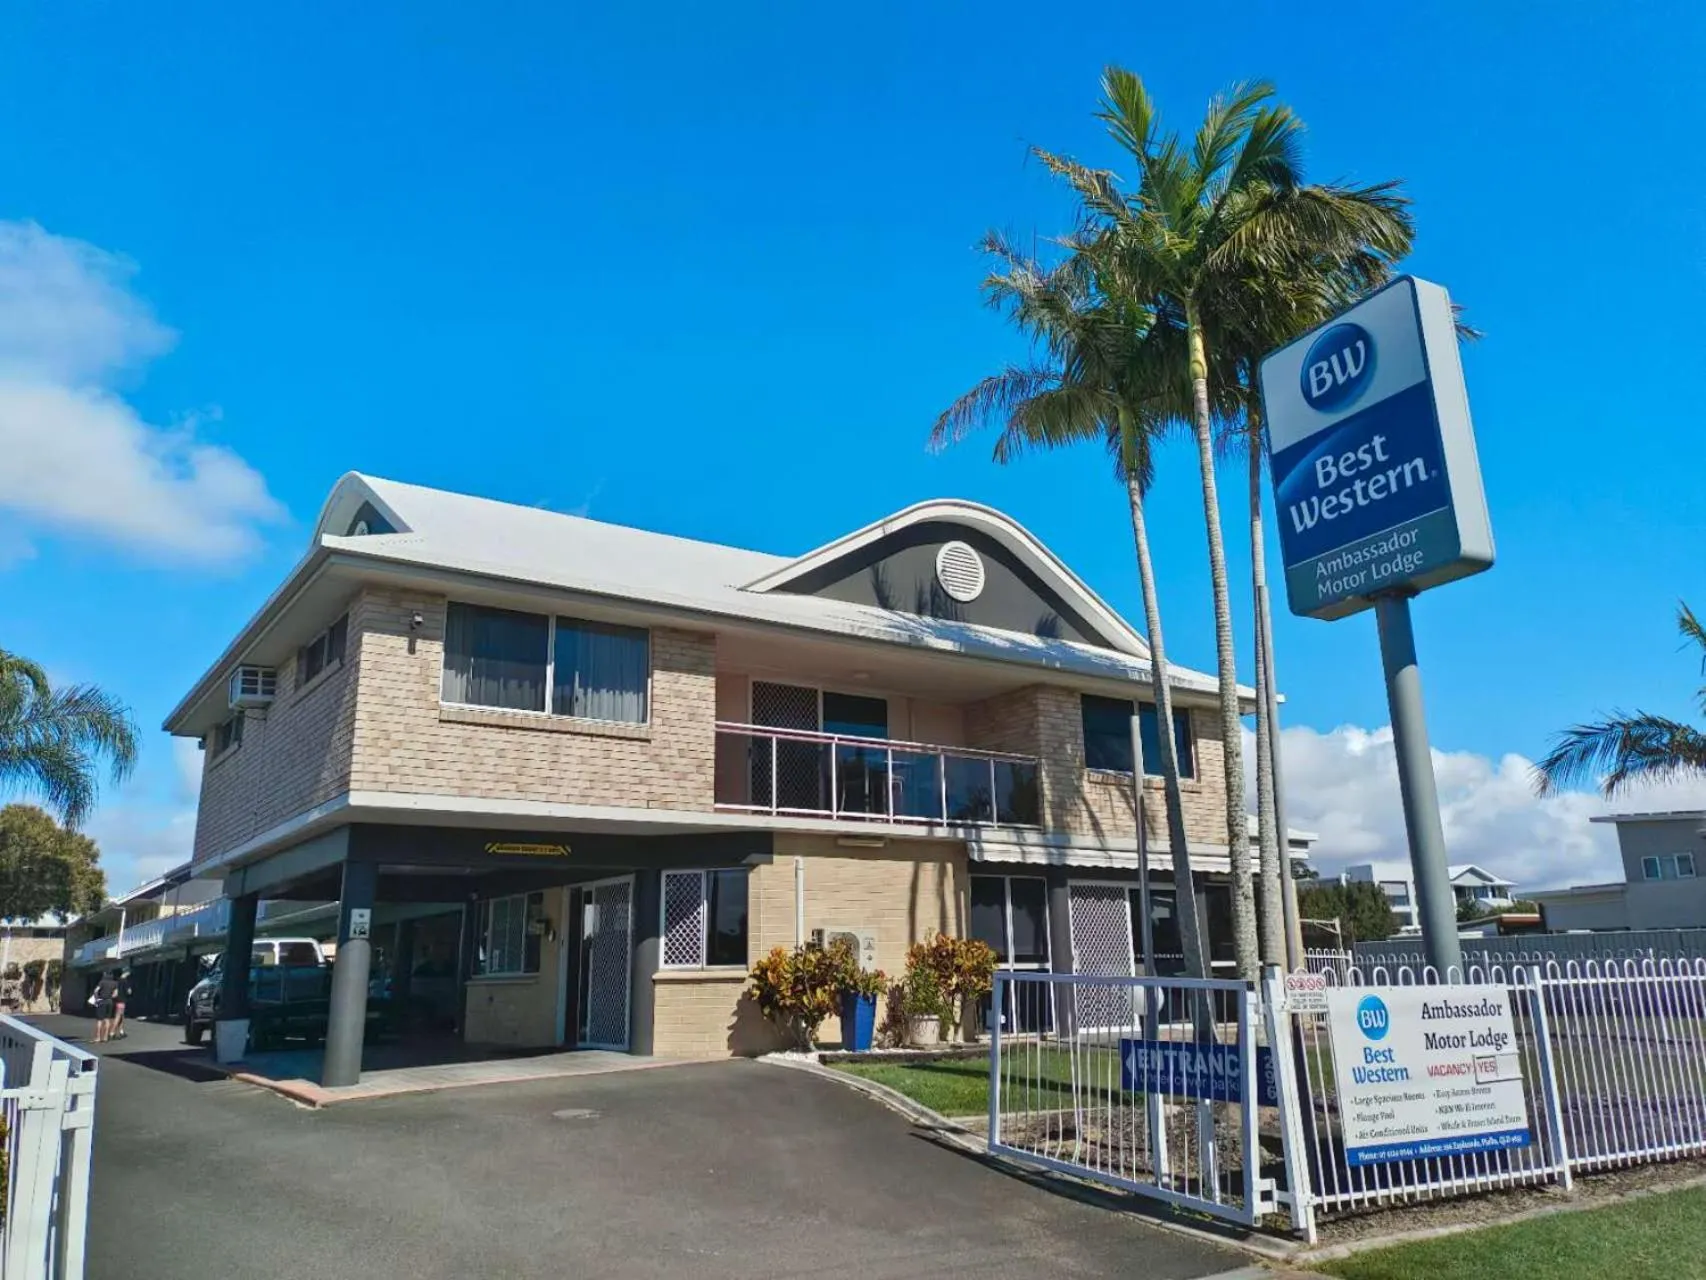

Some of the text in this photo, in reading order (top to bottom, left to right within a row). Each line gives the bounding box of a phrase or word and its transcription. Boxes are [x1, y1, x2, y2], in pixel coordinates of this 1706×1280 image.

[1309, 340, 1366, 399] BW
[1315, 434, 1389, 489] Best
[1289, 457, 1429, 535] Western
[1316, 528, 1419, 579] Ambassador
[1318, 550, 1424, 600] Motor Lodge
[1361, 1009, 1386, 1029] BW
[1421, 998, 1503, 1020] Ambassador
[1424, 1027, 1508, 1051] Motor Lodge
[1136, 1048, 1240, 1078] ENTRANC
[1363, 1047, 1395, 1064] Best
[1477, 1061, 1497, 1073] YES
[1352, 1066, 1410, 1084] Western
